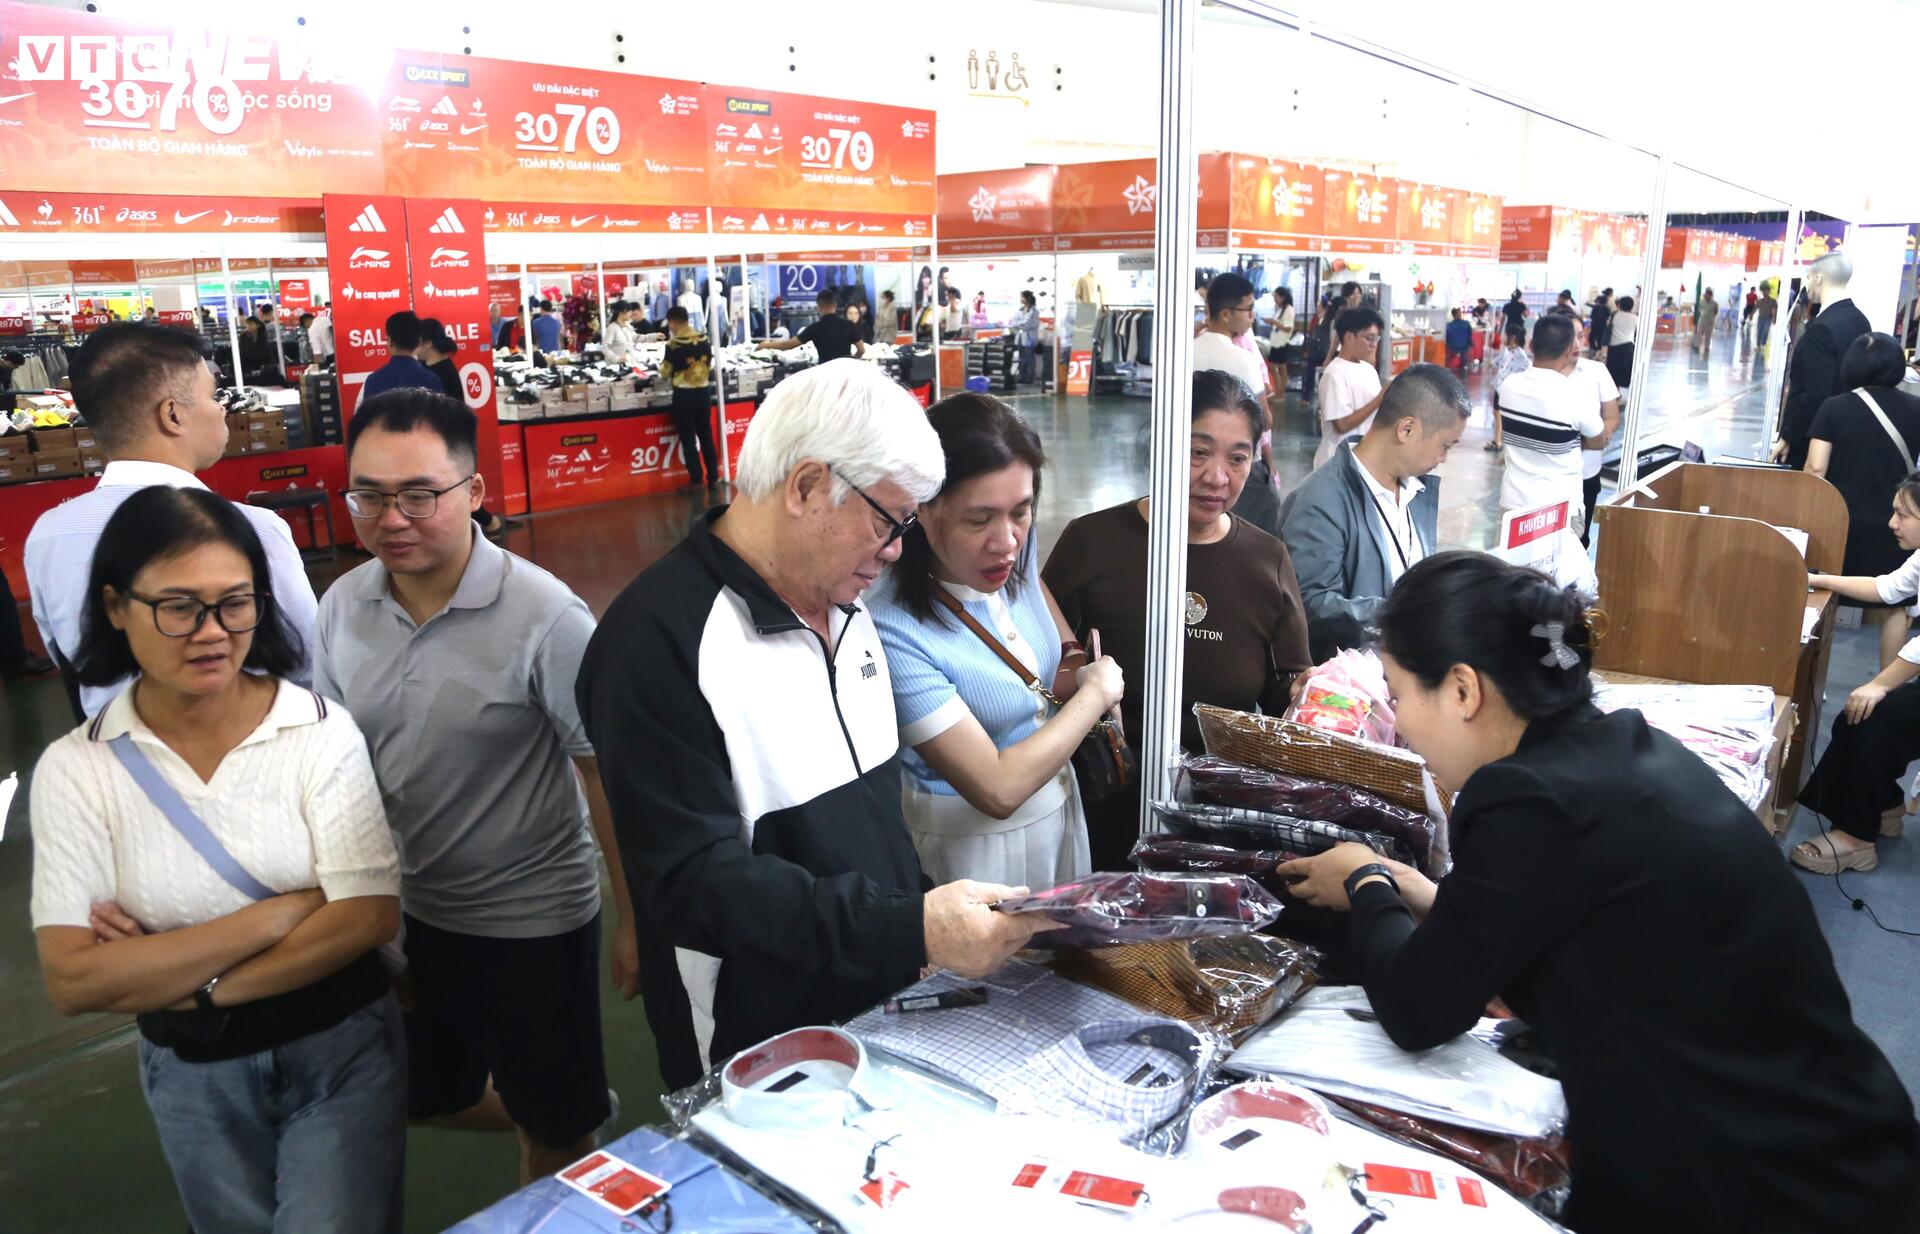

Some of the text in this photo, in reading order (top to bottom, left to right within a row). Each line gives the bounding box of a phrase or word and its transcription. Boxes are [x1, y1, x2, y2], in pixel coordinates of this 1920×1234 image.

[787, 265, 817, 291] 20
[349, 329, 388, 347] SAL
[631, 446, 658, 468] 30
[1187, 627, 1223, 641] VUTON
